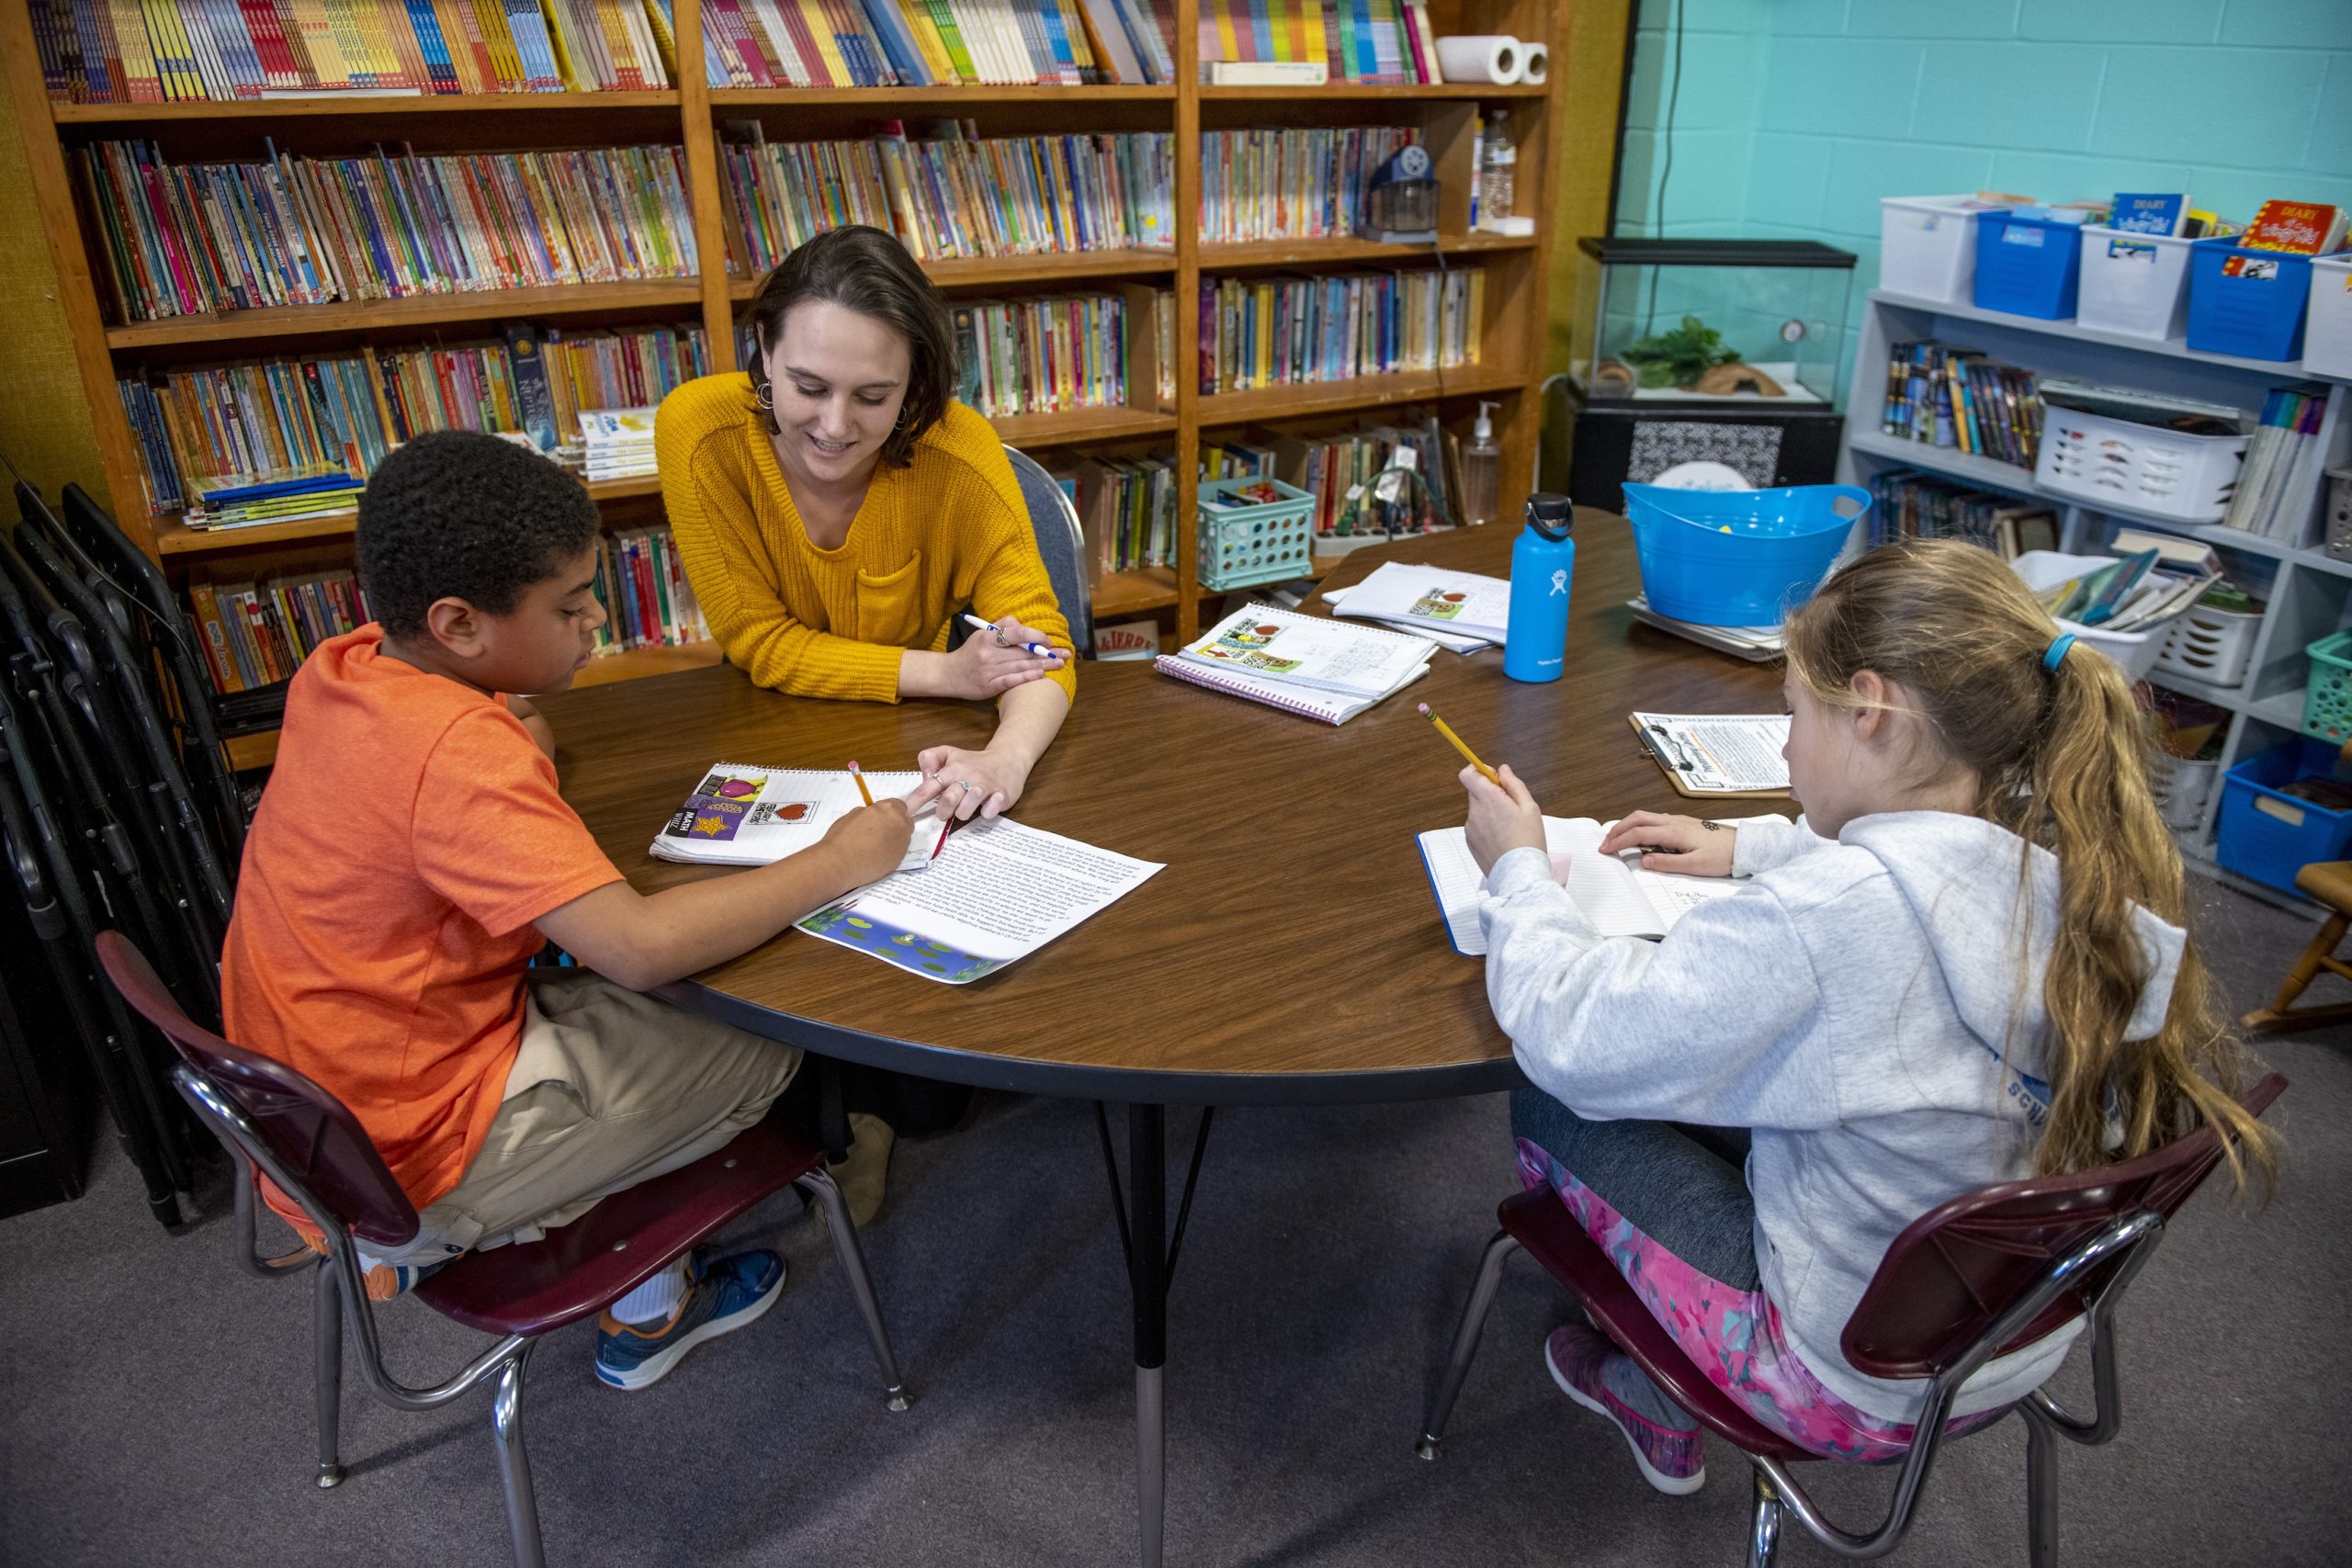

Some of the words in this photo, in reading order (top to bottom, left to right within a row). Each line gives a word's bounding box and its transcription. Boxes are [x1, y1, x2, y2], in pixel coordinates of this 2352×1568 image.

[2133, 199, 2167, 209] DIARY
[2280, 207, 2319, 220] DIARY
[2296, 227, 2320, 244] Kid
[518, 379, 539, 432] NEPTUNE
[670, 812, 684, 829] WHIZ
[680, 812, 695, 831] MATH
